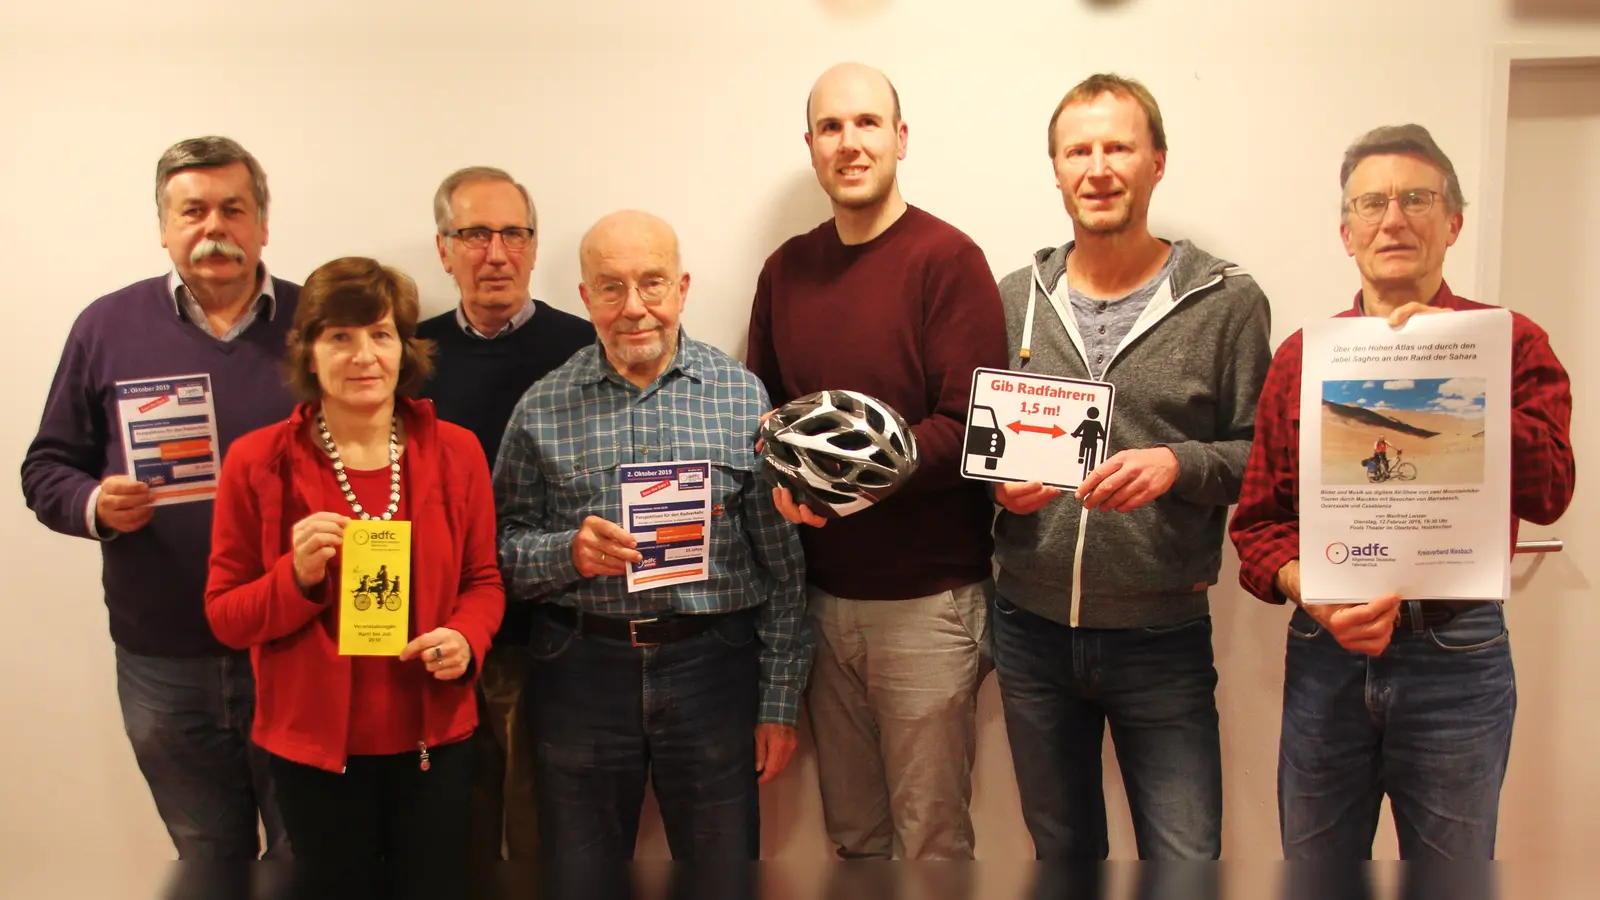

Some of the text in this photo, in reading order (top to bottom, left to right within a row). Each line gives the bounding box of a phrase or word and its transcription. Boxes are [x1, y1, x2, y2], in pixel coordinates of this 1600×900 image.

[1333, 344, 1350, 352] Über
[1352, 356, 1380, 364] Saghro
[991, 380, 1096, 402] Gib Radfahrern
[1020, 402, 1060, 416] 1,5 m!
[370, 530, 396, 540] adfc
[1352, 543, 1388, 556] adfc
